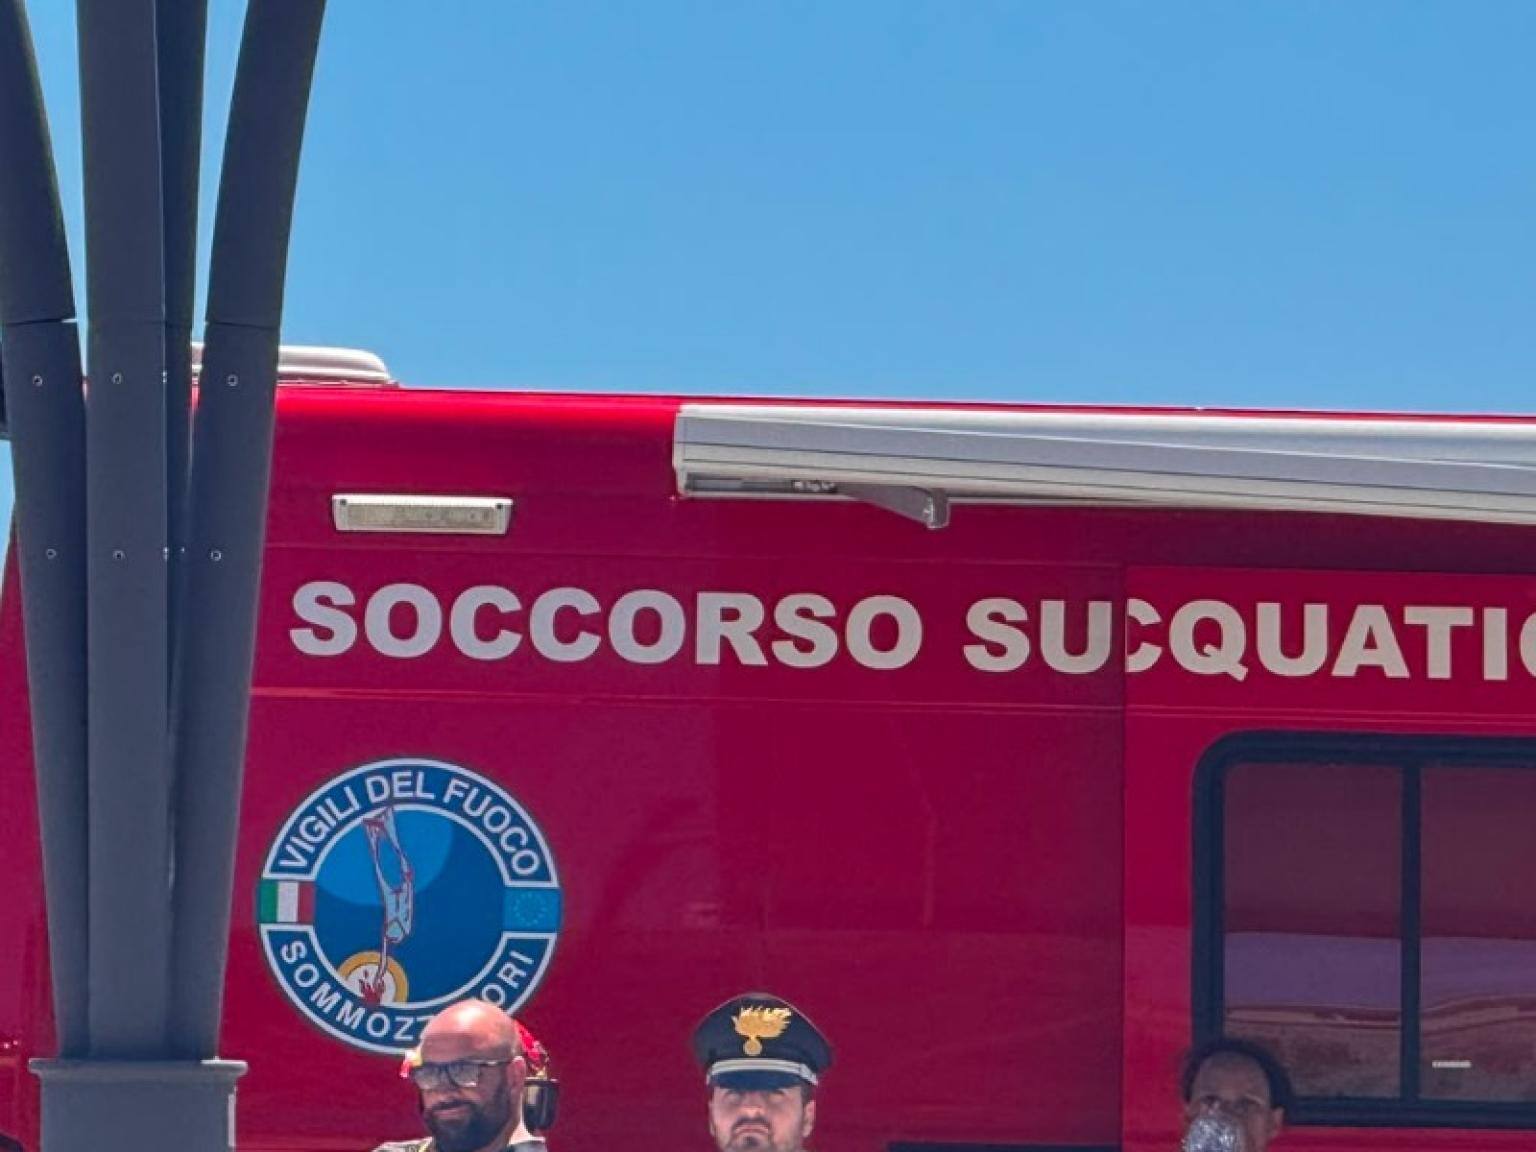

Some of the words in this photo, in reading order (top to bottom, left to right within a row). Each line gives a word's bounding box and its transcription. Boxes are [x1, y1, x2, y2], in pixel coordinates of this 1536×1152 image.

[289, 580, 923, 670] SOCCORSO
[280, 786, 361, 869] VIGILI
[364, 771, 436, 803] DEL
[443, 778, 540, 876] FUOCO
[280, 940, 535, 1042] SOMMOZORI
